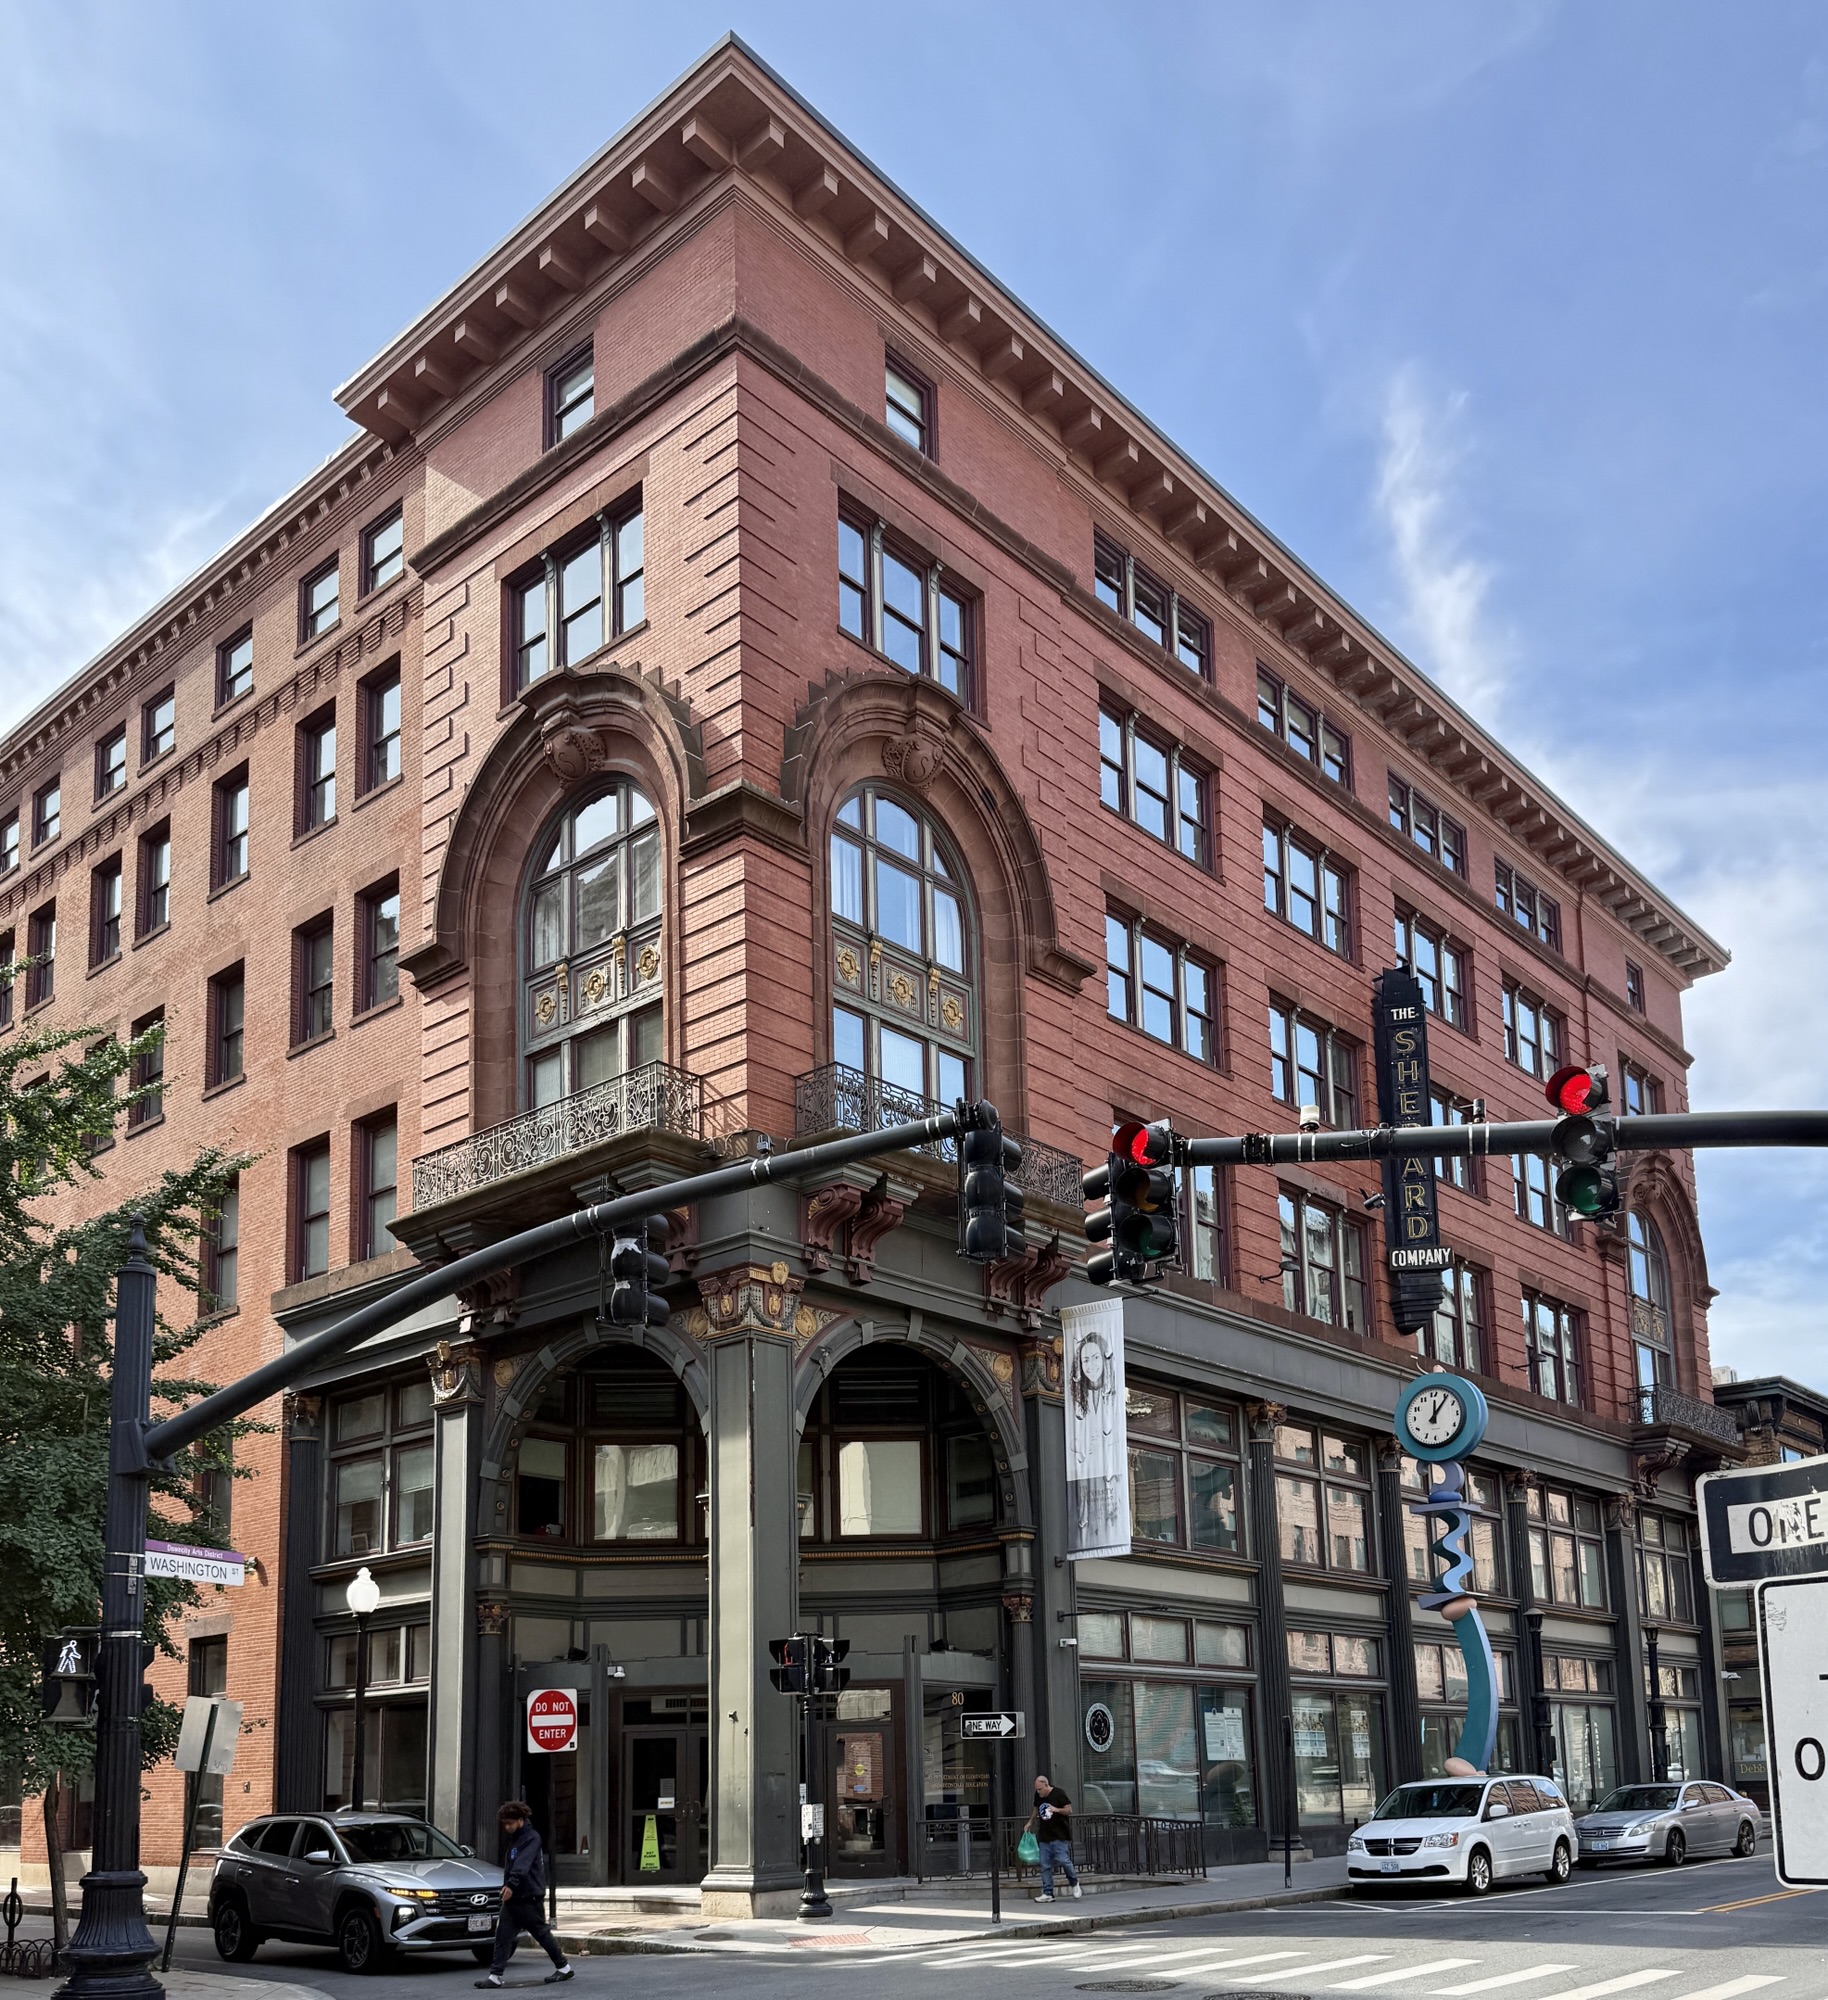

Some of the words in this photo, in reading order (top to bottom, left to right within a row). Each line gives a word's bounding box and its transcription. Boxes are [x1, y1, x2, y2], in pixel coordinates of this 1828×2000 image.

[1391, 1007, 1418, 1020] THE
[1394, 1030, 1428, 1239] SHEARD
[1391, 1248, 1451, 1267] COMPANY
[167, 1544, 190, 1556] Downcity
[192, 1548, 203, 1556] Arts
[204, 1549, 223, 1559] District
[150, 1557, 227, 1579] WASHINGTON
[951, 1691, 964, 1705] 80
[535, 1702, 548, 1712] DO
[552, 1702, 569, 1711] NOT
[985, 1721, 1001, 1730] WAY
[539, 1728, 566, 1739] ENTER
